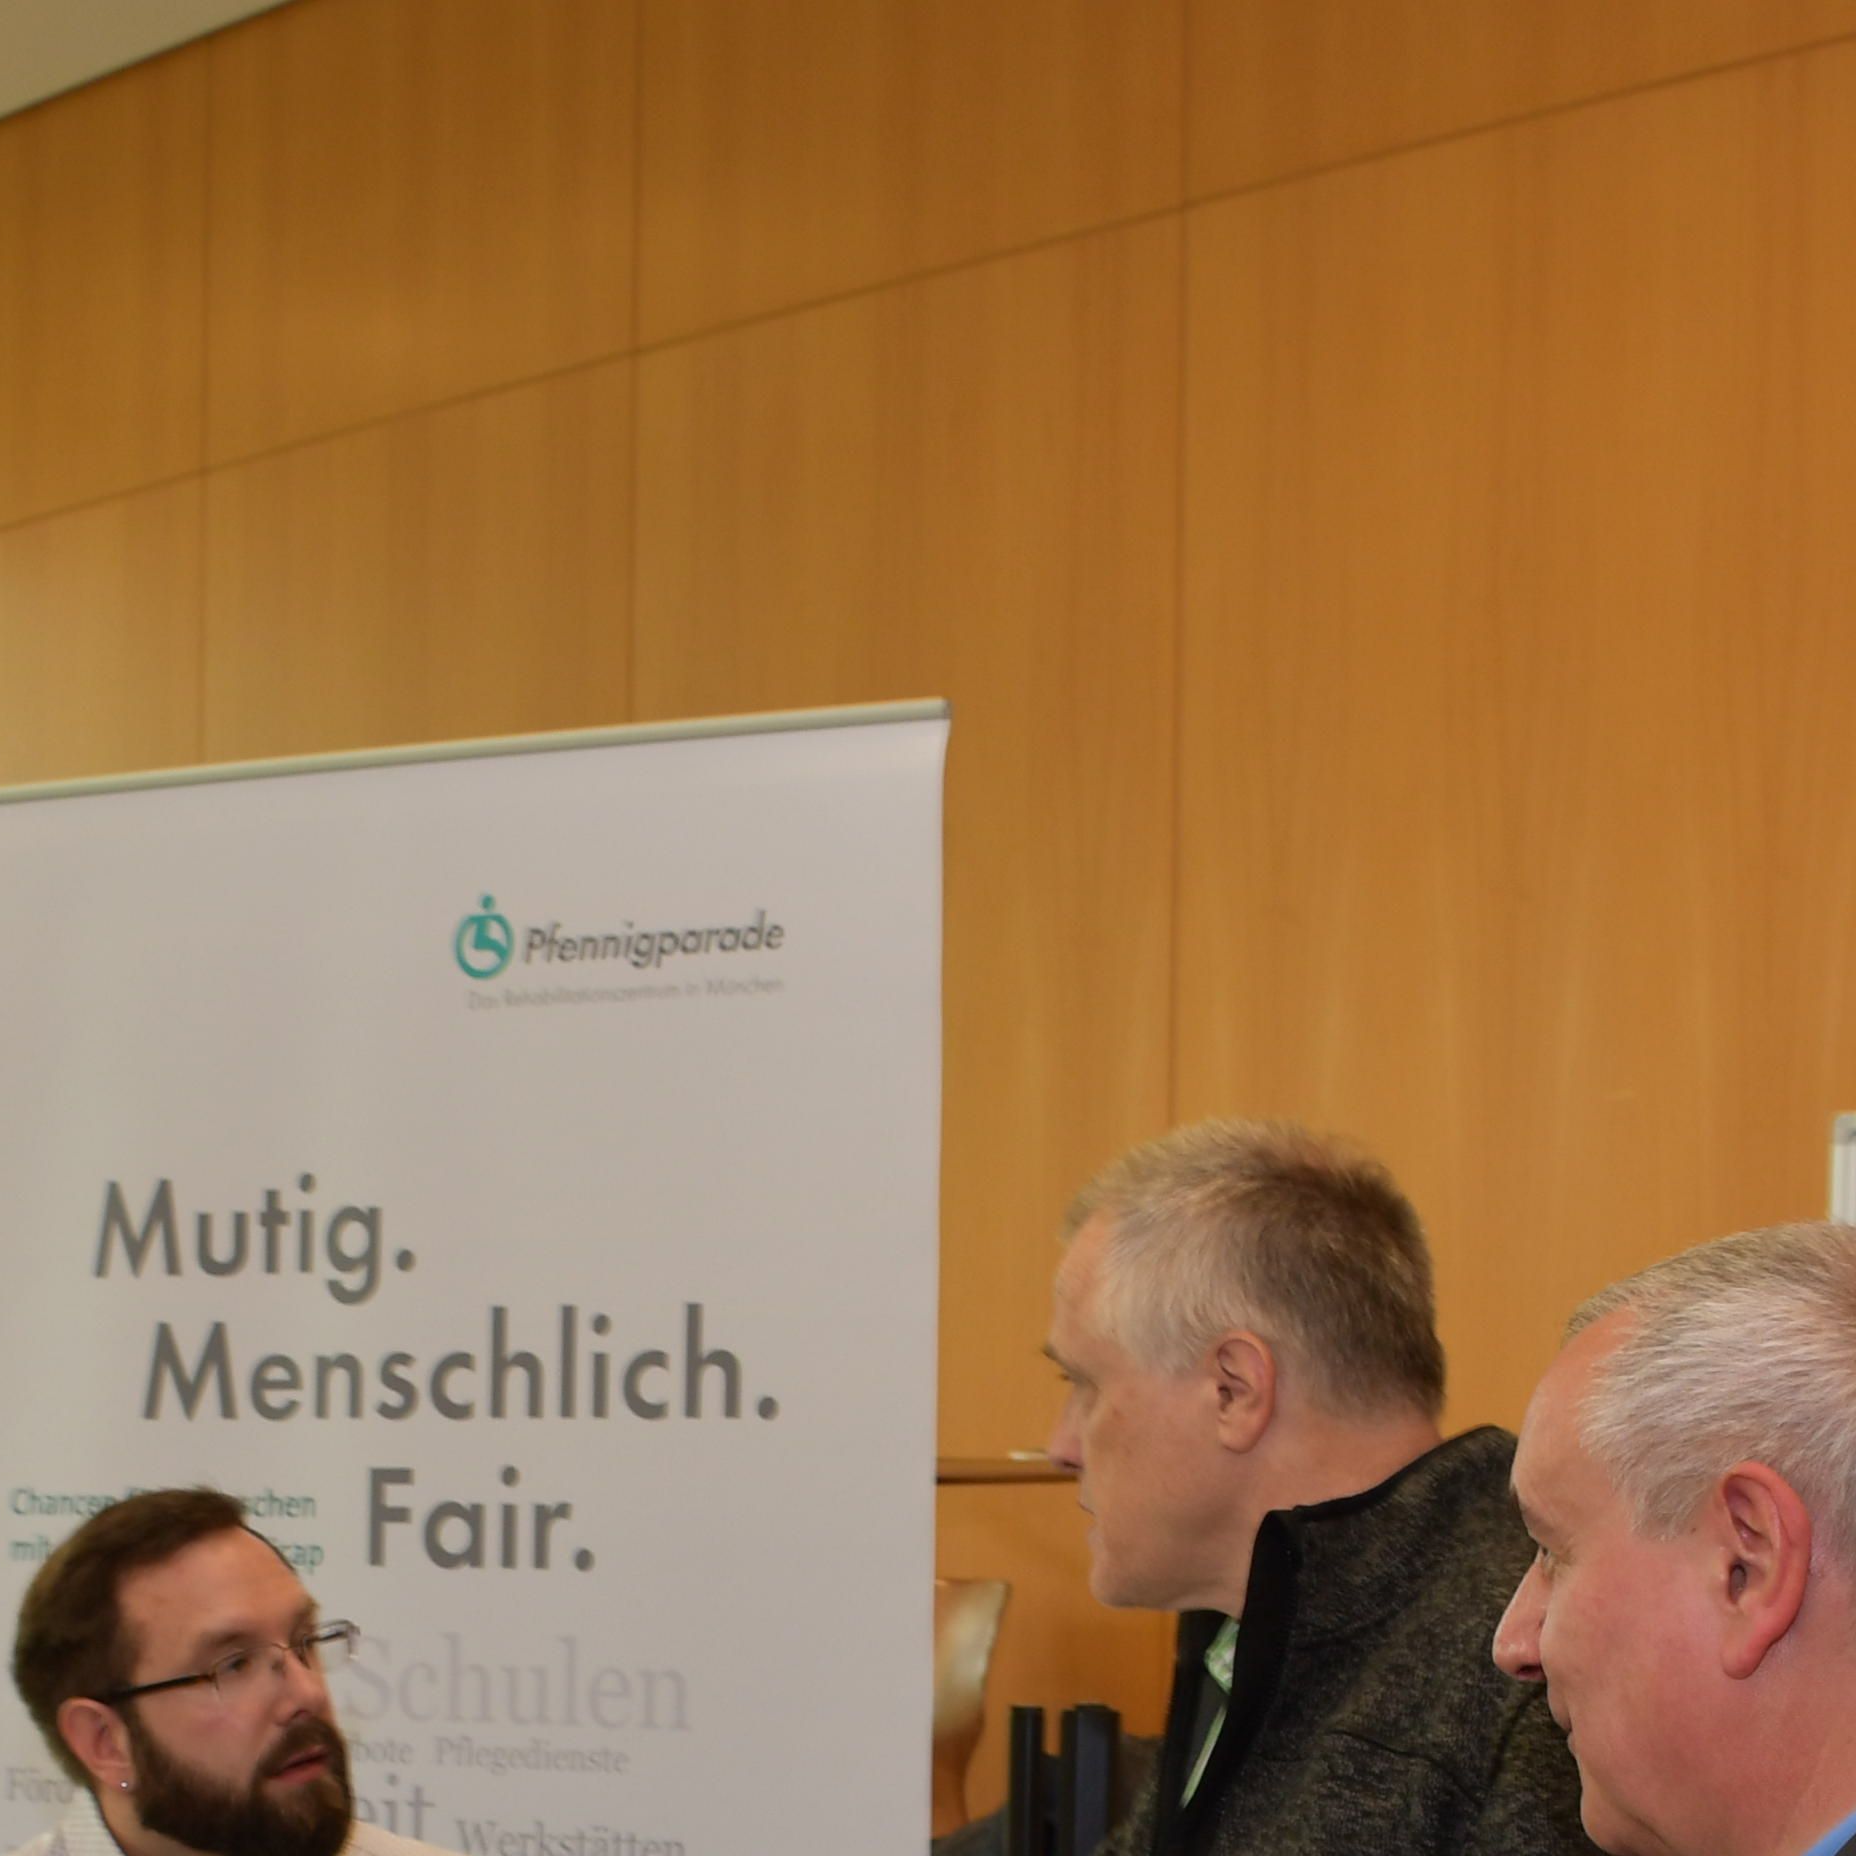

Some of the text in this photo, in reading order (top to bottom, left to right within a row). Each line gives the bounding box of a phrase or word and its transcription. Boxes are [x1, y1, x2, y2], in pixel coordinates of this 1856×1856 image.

[525, 907, 785, 969] Pfennigparade
[93, 1172, 417, 1305] Mutig.
[142, 1303, 781, 1421] Menschlich.
[366, 1465, 596, 1571] Fair.
[345, 1632, 692, 1731] Schulen
[434, 1735, 631, 1776] Pflegedienste
